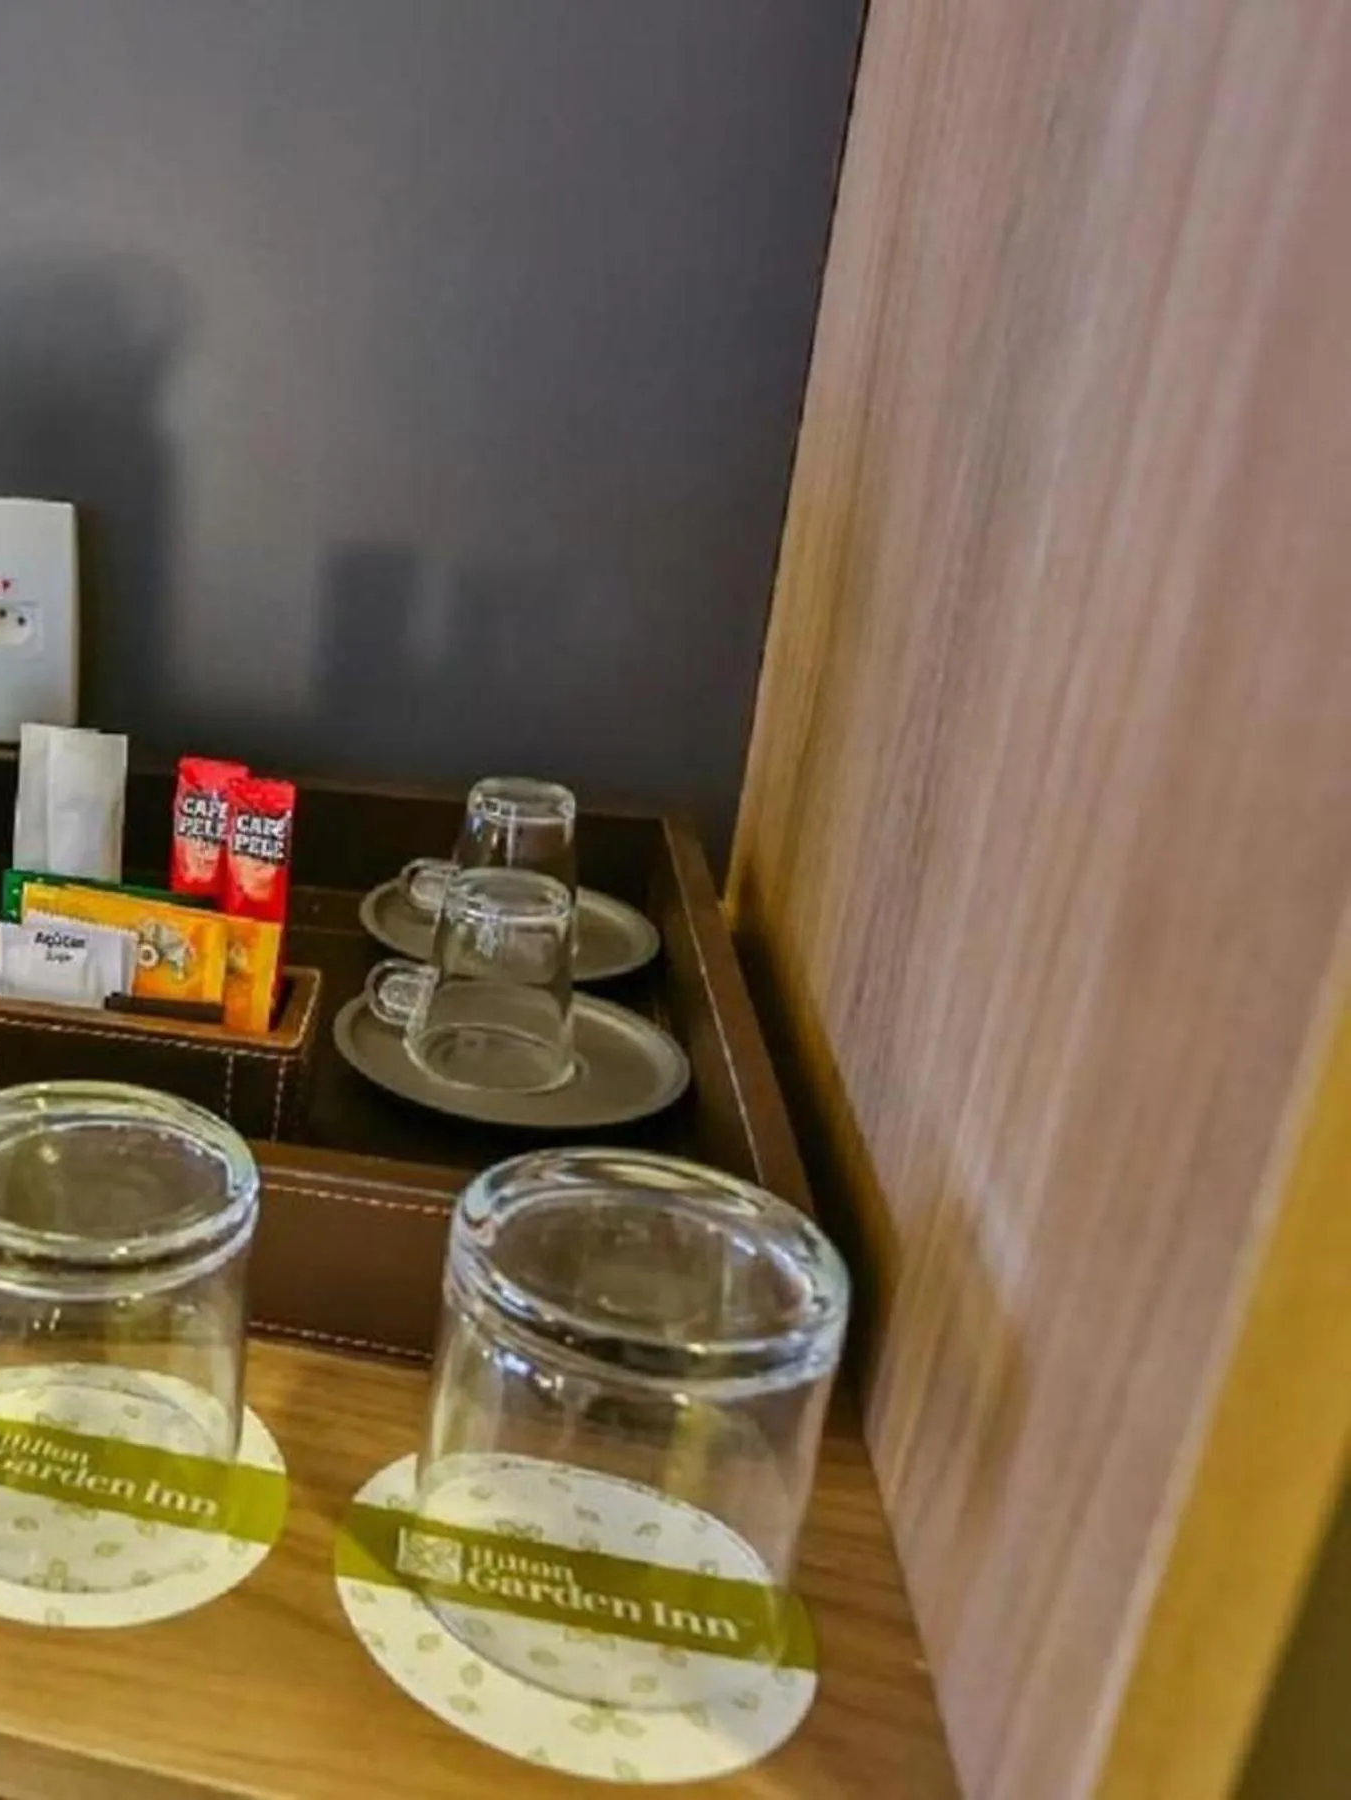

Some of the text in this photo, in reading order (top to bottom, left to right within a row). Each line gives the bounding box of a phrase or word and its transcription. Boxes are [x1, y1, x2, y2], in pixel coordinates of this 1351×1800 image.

[144, 1478, 219, 1518] Inn
[465, 1565, 740, 1642] Garden Inn
